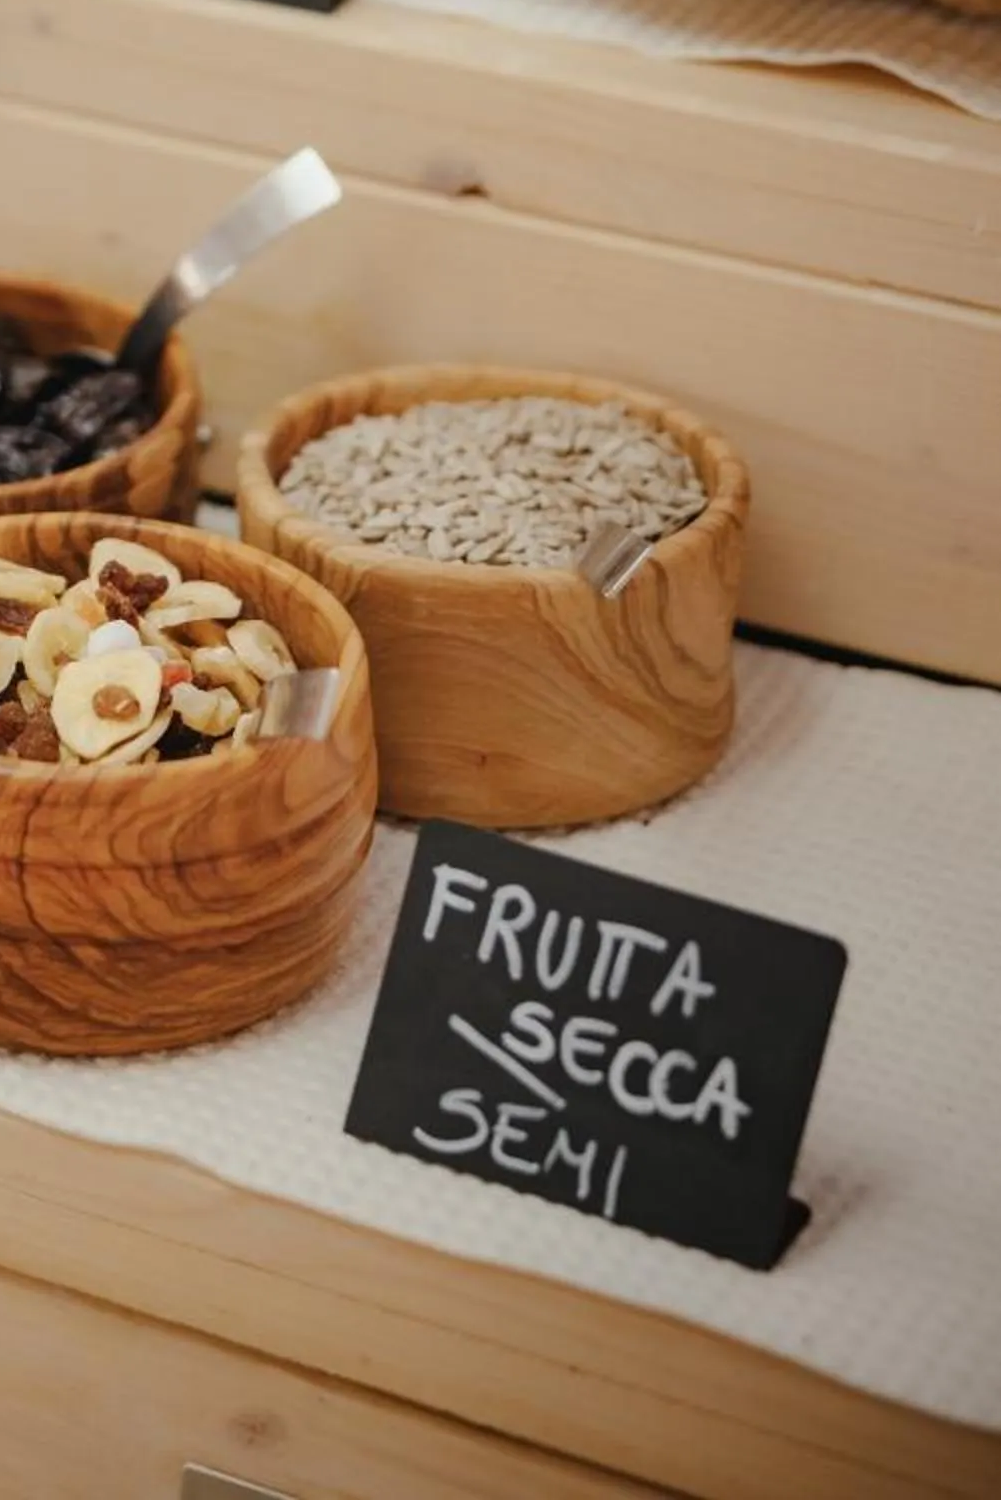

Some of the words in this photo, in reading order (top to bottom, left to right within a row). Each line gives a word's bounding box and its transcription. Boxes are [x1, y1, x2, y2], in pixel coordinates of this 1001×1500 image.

[422, 864, 716, 1017] FRUTTA
[502, 1001, 752, 1140] SECCA
[413, 1088, 627, 1219] SEMI
